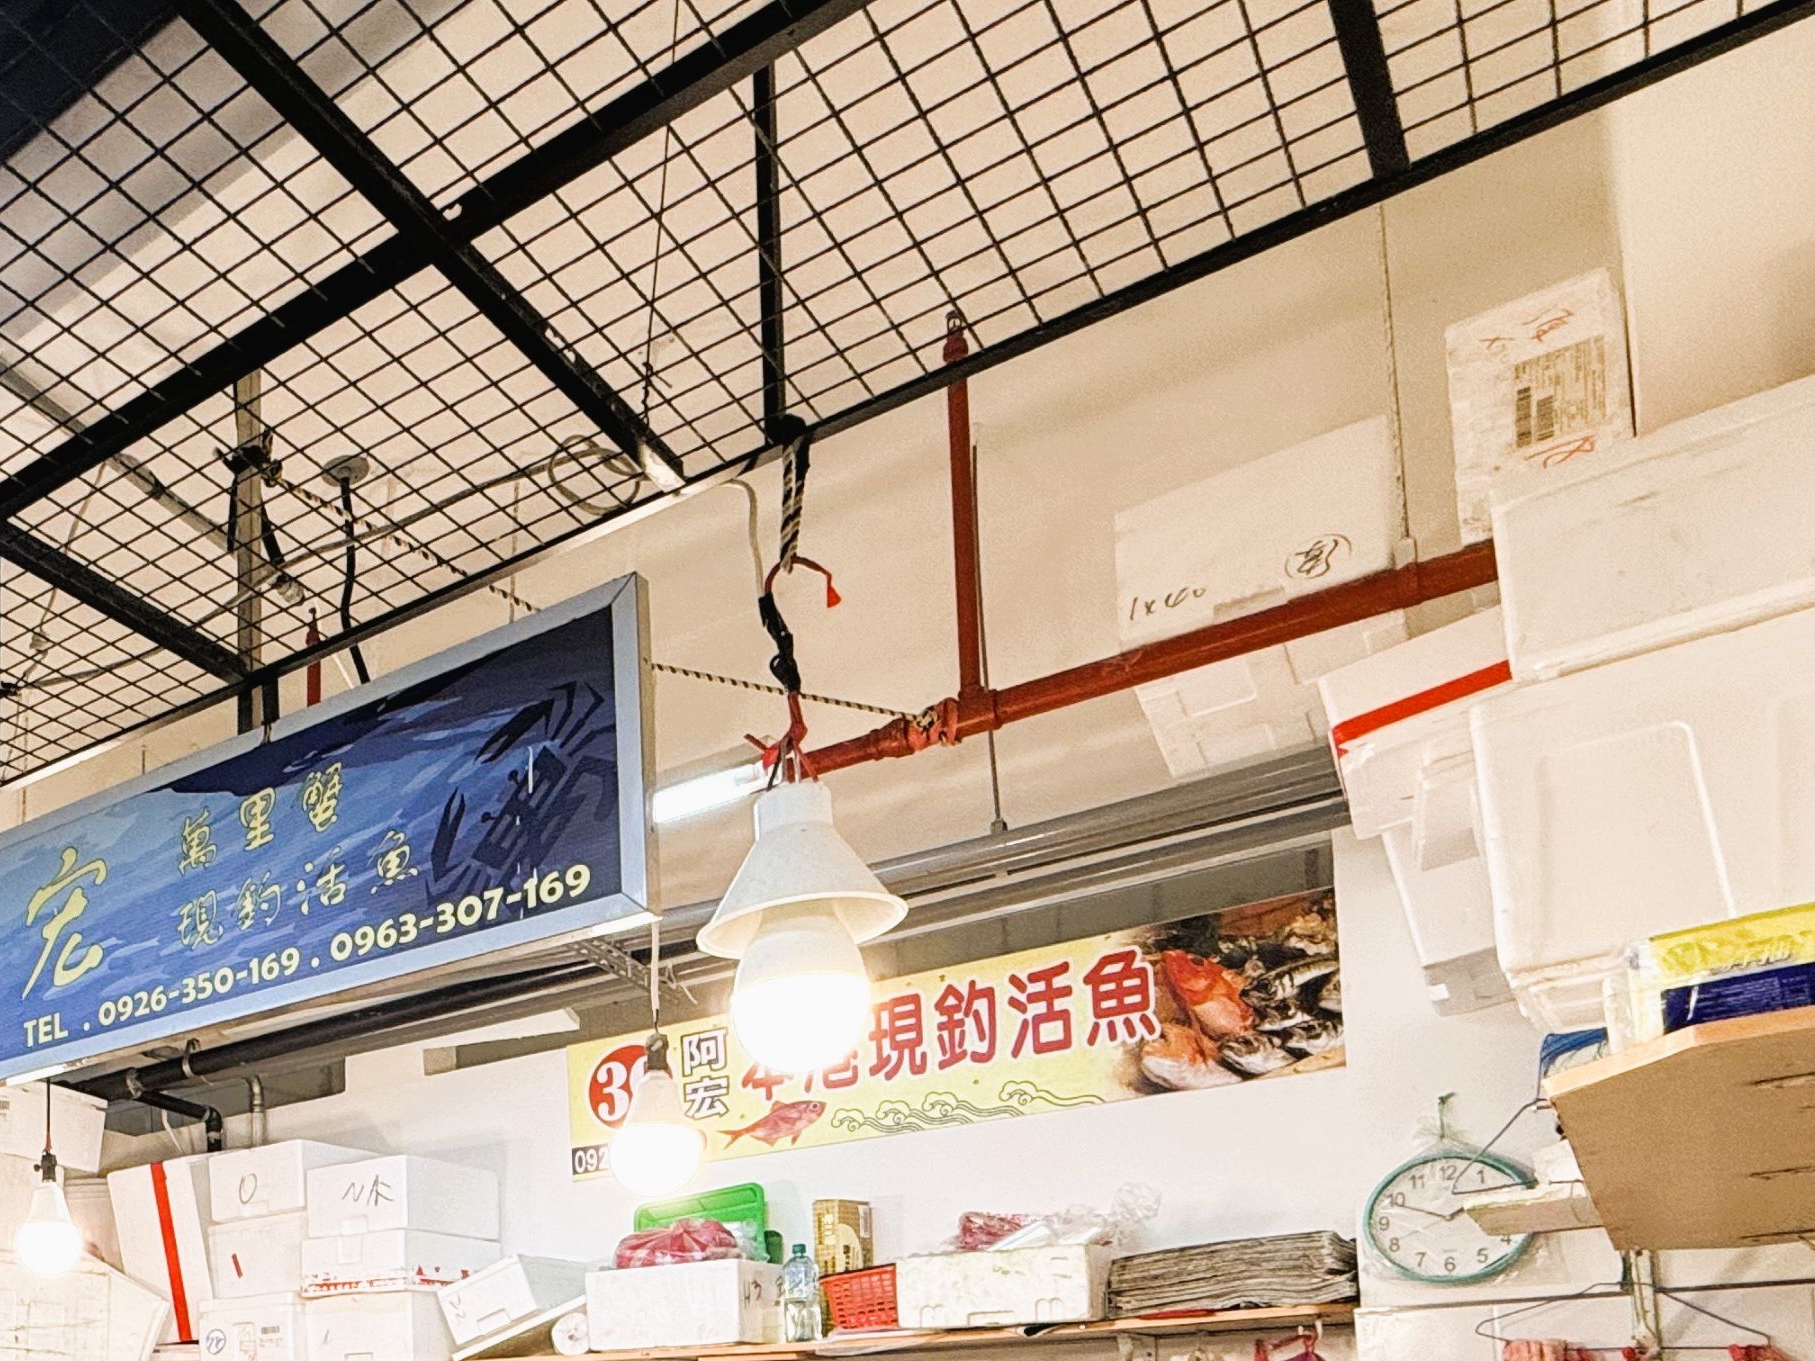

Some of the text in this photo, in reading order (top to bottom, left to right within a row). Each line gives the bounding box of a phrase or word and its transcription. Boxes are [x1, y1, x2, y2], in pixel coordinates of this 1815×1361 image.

[177, 829, 418, 952] 現釣活魚
[23, 863, 592, 1048] TEL 0926-350-169 0963-307-169
[680, 1026, 730, 1121] 阿宏
[1440, 1165, 1456, 1180] 12
[1477, 1170, 1485, 1184] 1
[1410, 1174, 1425, 1189] 11
[1388, 1192, 1405, 1207] 10
[1378, 1216, 1390, 1231] 9
[1389, 1237, 1400, 1252] 8
[1416, 1252, 1426, 1267] 7
[1476, 1248, 1488, 1263] 5
[1444, 1257, 1456, 1272] 6
